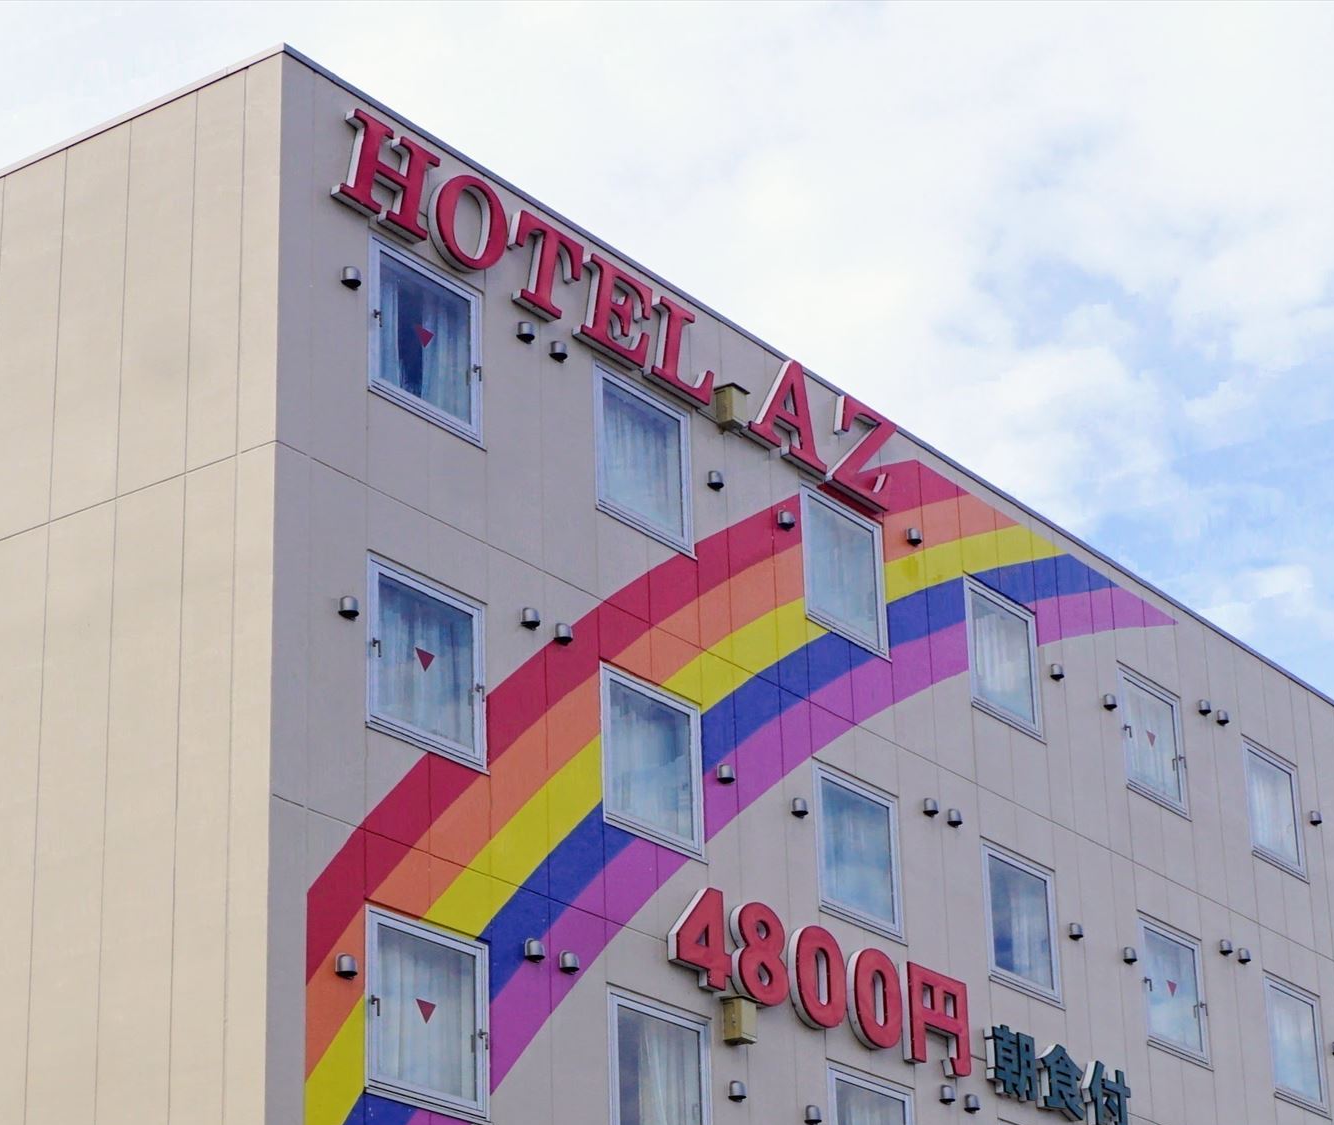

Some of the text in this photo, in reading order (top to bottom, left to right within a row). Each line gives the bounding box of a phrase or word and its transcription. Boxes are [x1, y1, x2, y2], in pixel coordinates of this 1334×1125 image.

[332, 108, 898, 515] HOTEL AZ
[669, 887, 972, 1078] 4800円
